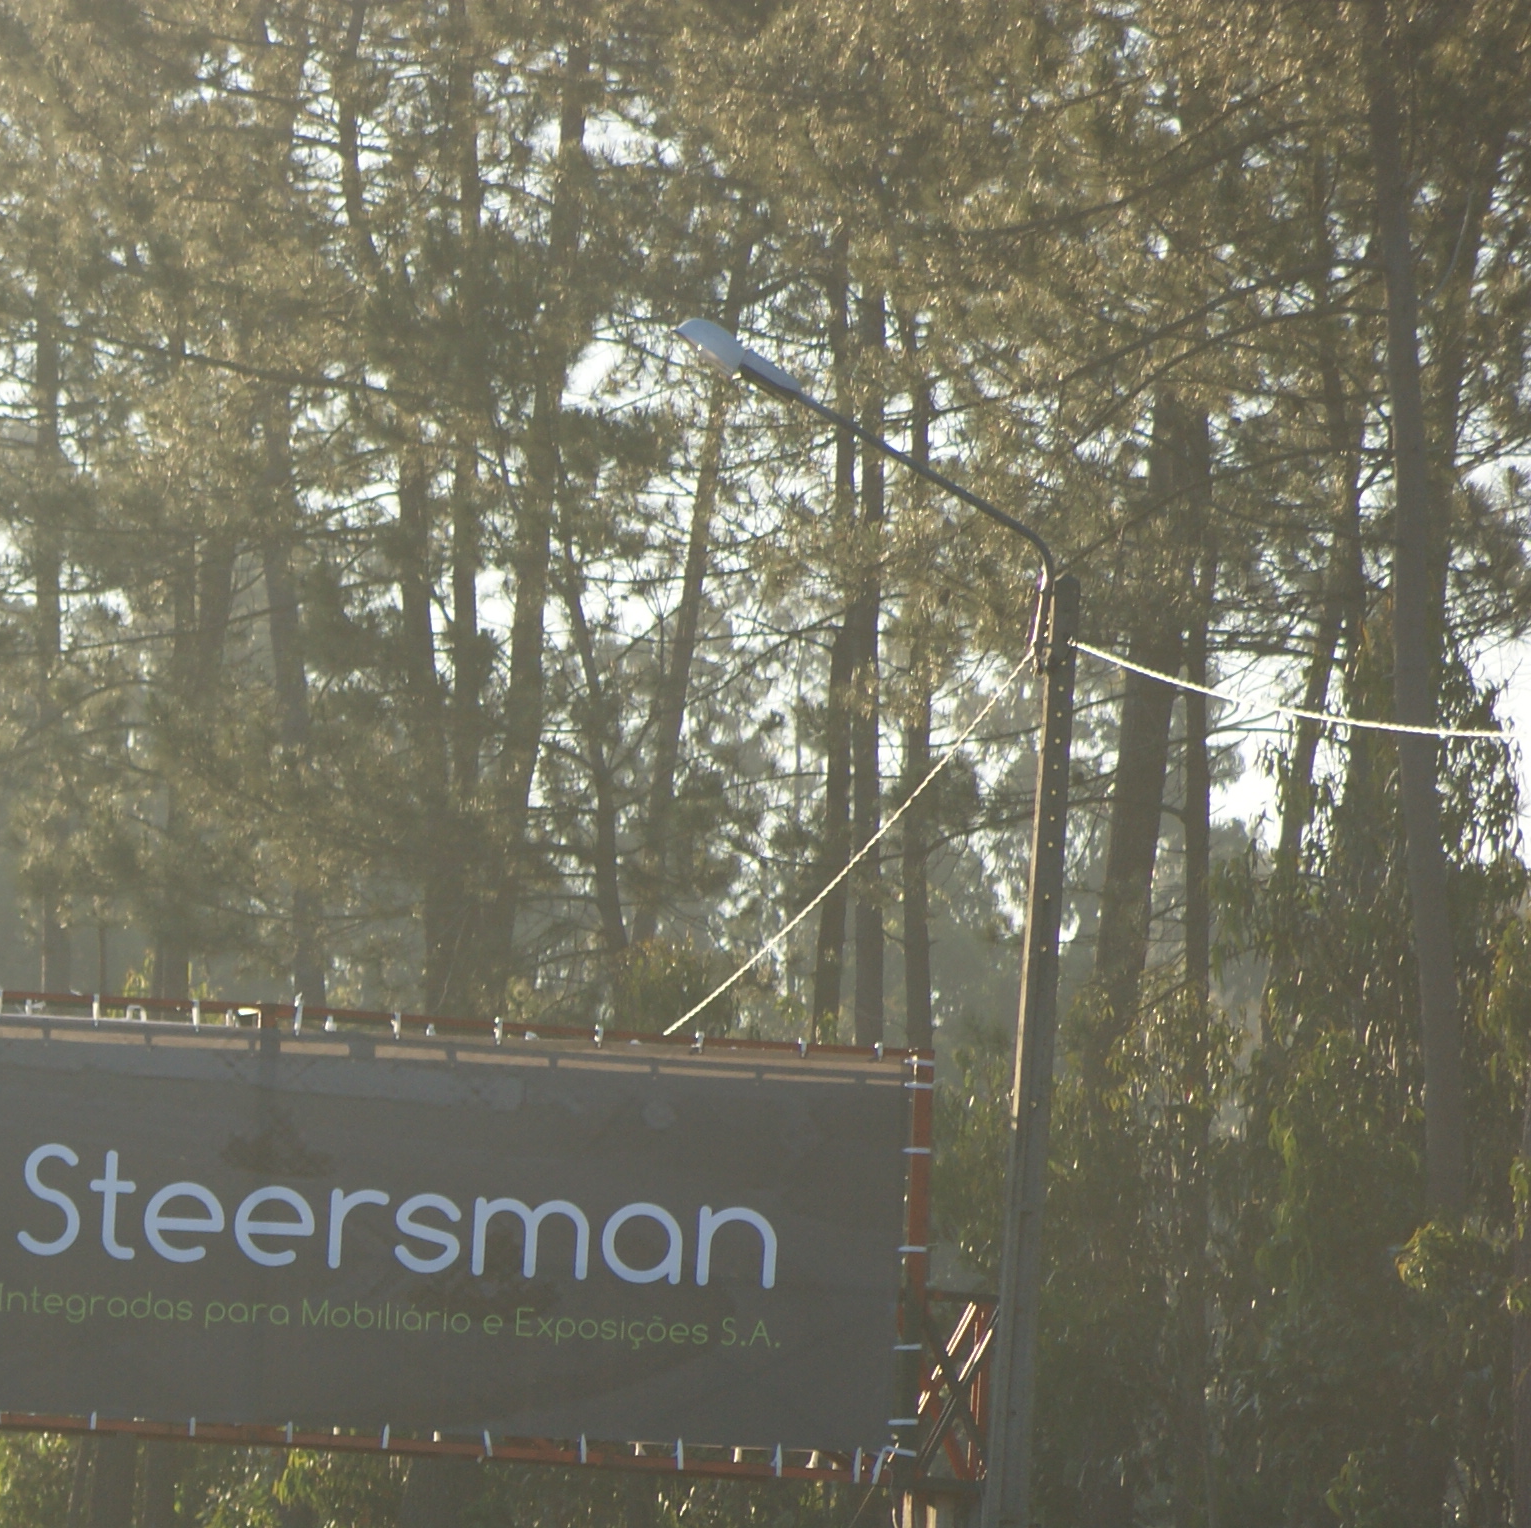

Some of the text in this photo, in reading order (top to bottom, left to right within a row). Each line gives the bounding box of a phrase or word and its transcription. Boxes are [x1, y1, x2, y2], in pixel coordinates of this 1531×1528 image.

[17, 1143, 779, 1289] Steersman
[205, 1302, 290, 1328] para
[301, 1299, 471, 1335] Mobiliário
[483, 1312, 503, 1335] e
[515, 1307, 709, 1350] Exposições
[721, 1316, 781, 1349] S.A.
